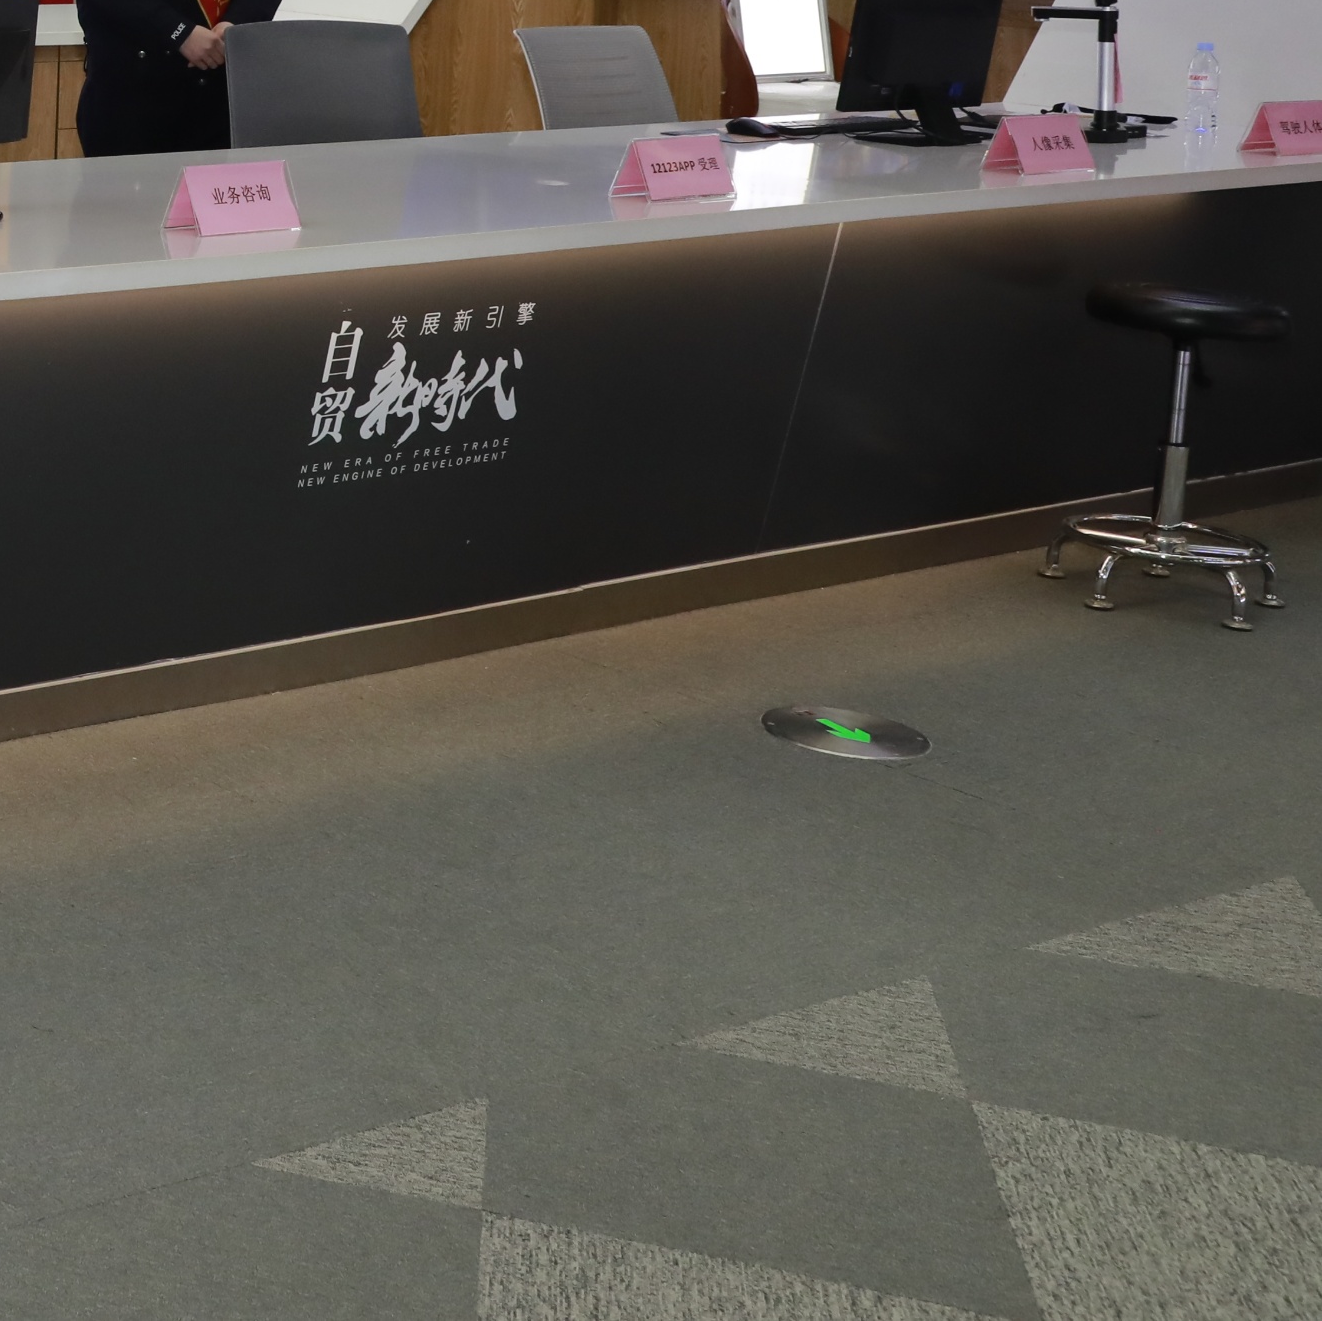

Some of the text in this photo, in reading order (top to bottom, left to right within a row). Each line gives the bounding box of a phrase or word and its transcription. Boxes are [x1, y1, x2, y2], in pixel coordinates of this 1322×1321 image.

[171, 22, 187, 40] POLICE
[1032, 135, 1075, 151] 人像采集
[651, 157, 720, 174] 12123APP 受理
[211, 184, 271, 205] 业务咨询
[387, 302, 537, 339] 发展新引擎
[307, 320, 364, 446] 自贸
[297, 450, 508, 488] NEW ENGINE OF DEVELOPMENT
[300, 437, 510, 474] NEW ERA OF FREE TRADE
